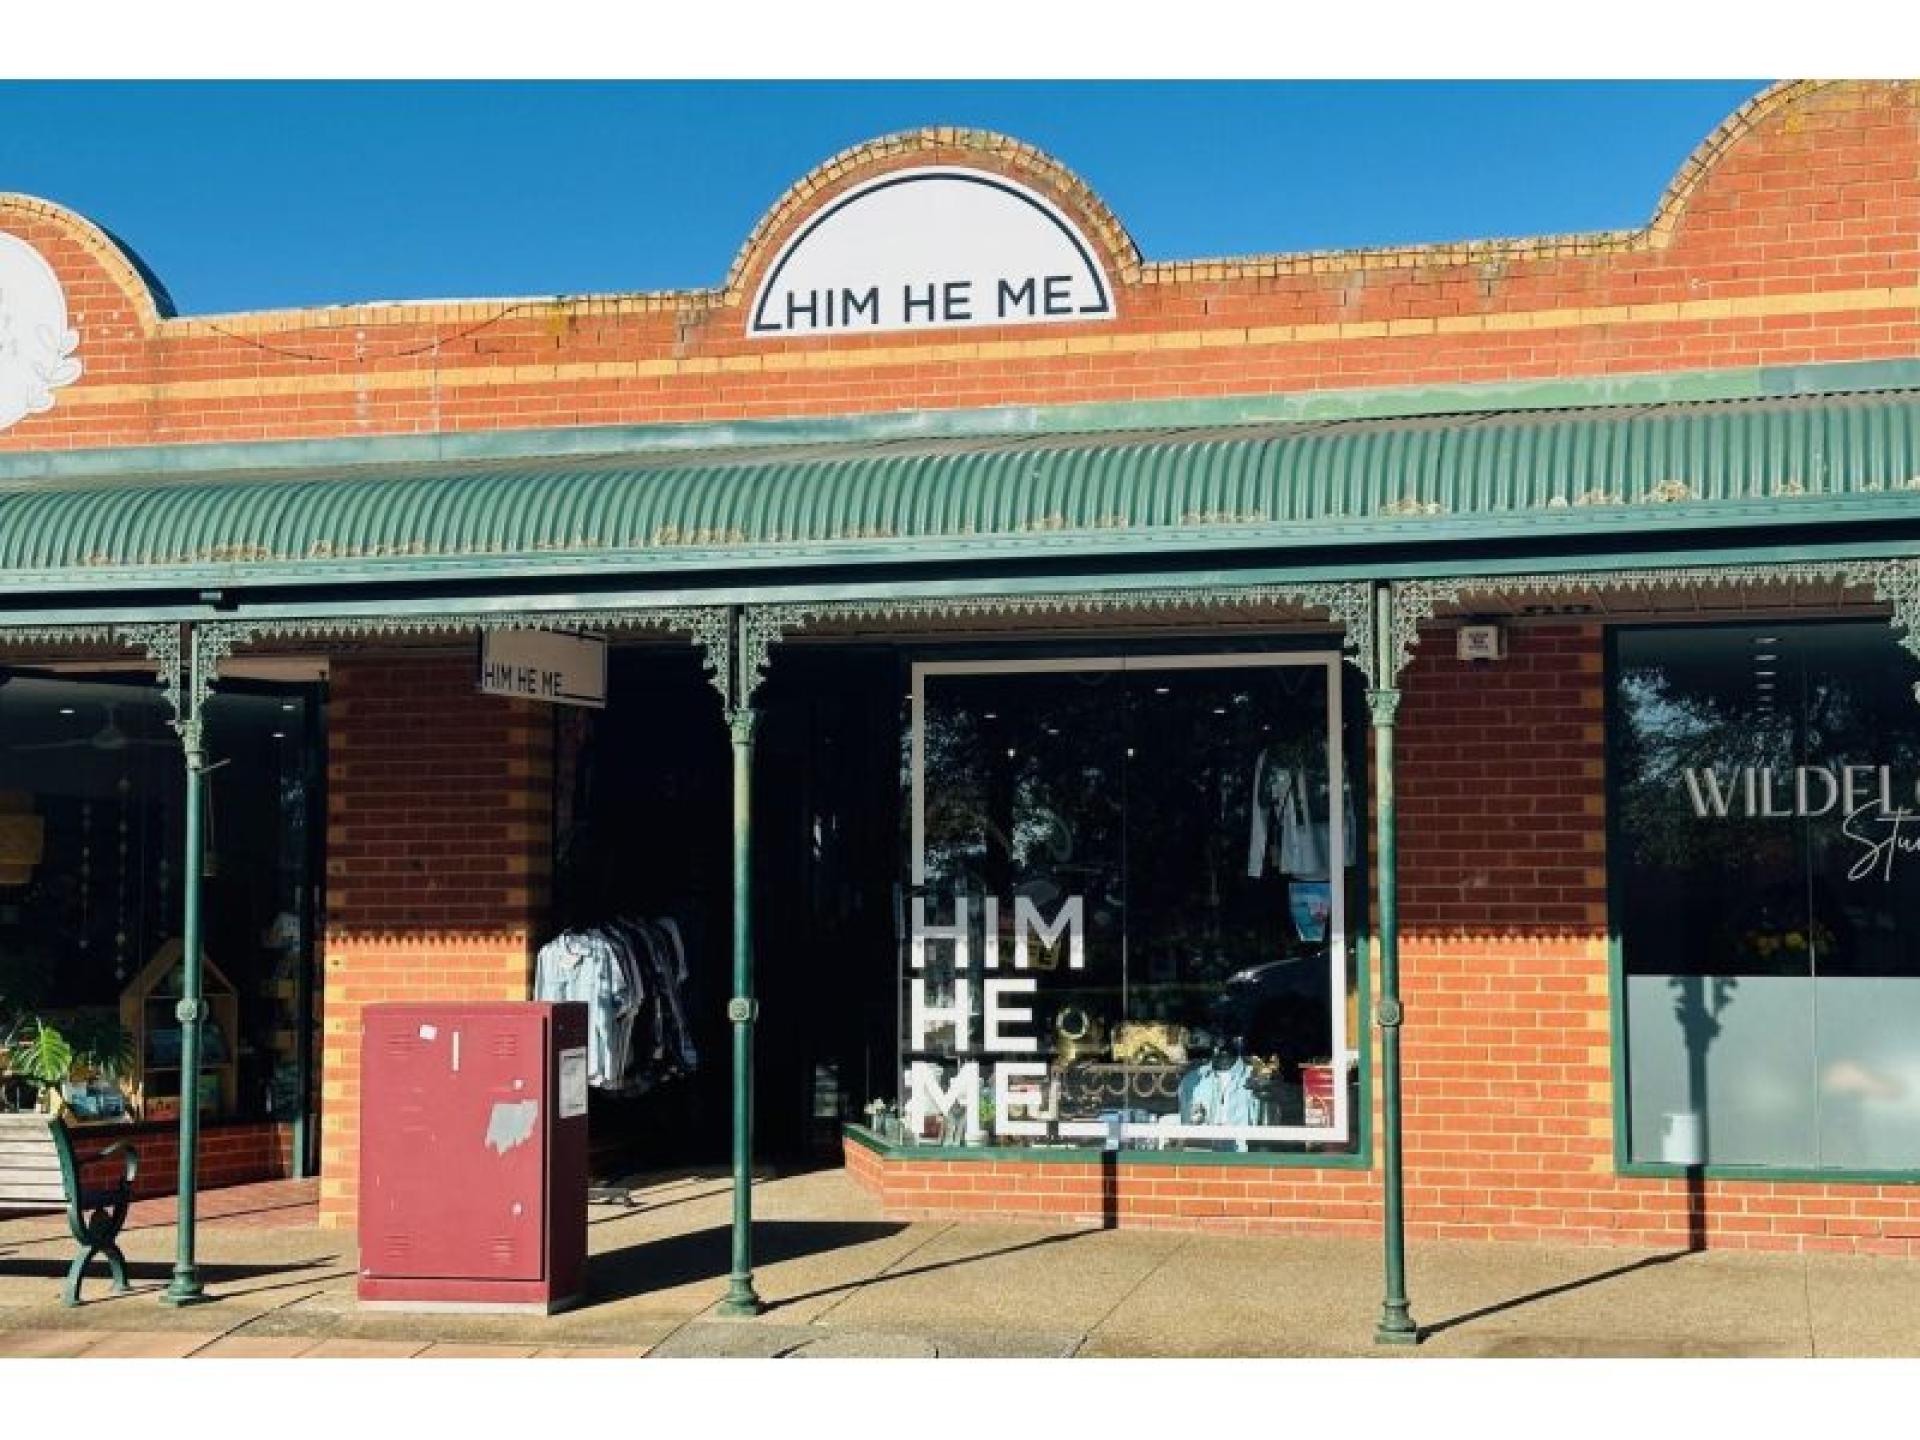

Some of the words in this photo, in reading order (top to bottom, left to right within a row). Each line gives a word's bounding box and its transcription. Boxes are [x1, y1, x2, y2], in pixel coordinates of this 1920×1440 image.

[786, 287, 879, 329] HIM
[903, 281, 972, 323] HE
[997, 275, 1073, 318] ME
[484, 662, 512, 689] HIM
[517, 666, 537, 694] HE
[541, 671, 562, 696] ME
[1682, 764, 1920, 818] WILDFL
[1843, 798, 1920, 881] Stu
[911, 895, 1085, 970] HIM
[911, 978, 1038, 1052] HE
[911, 1060, 1048, 1139] ME
